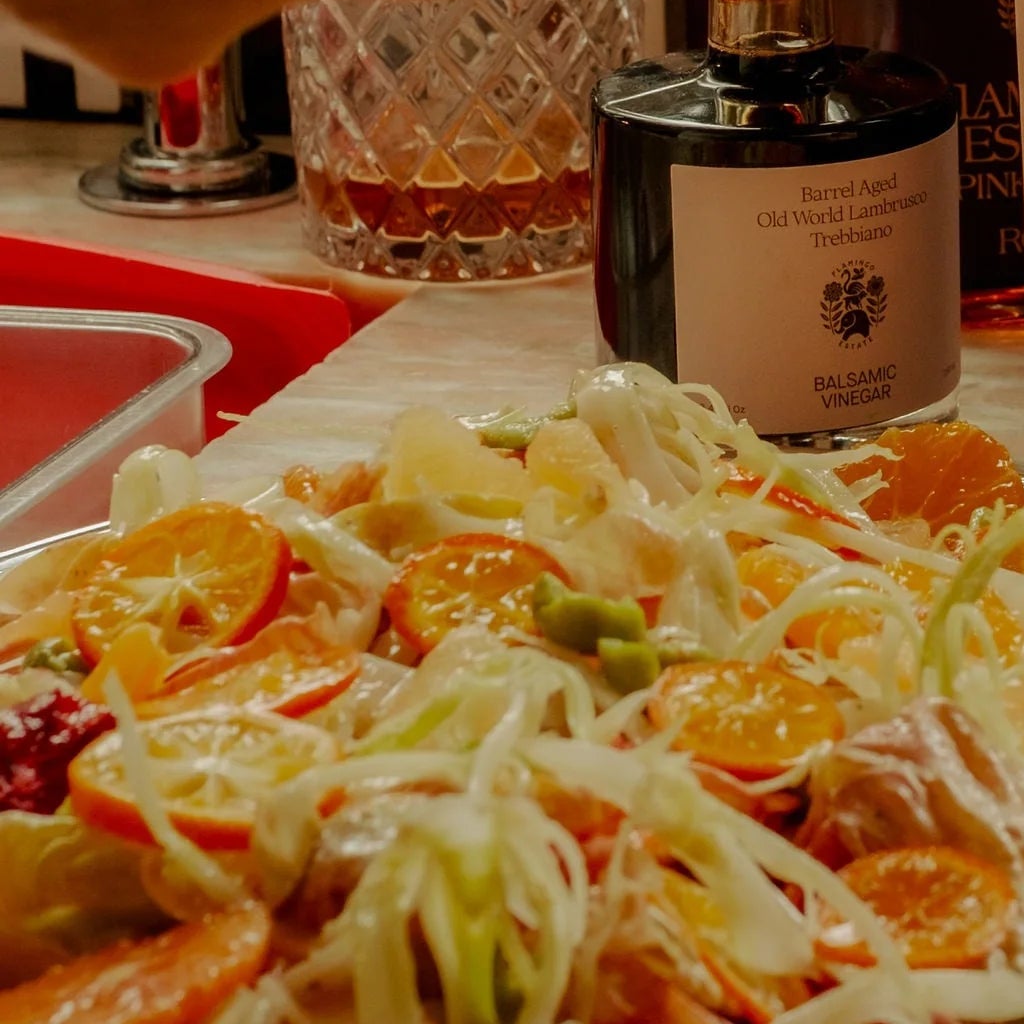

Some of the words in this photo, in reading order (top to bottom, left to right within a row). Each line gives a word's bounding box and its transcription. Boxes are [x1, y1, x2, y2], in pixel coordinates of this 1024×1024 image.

[800, 181, 855, 203] Barrel
[859, 173, 898, 198] Aged
[756, 210, 789, 228] Old
[791, 205, 844, 226] World
[849, 191, 928, 221] Lambrusco
[810, 224, 893, 249] Trebbiano
[831, 259, 876, 277] FLAMINGO
[838, 336, 874, 350] ESTATE
[814, 364, 897, 392] BALSAMIC
[821, 384, 892, 409] VINEGAR
